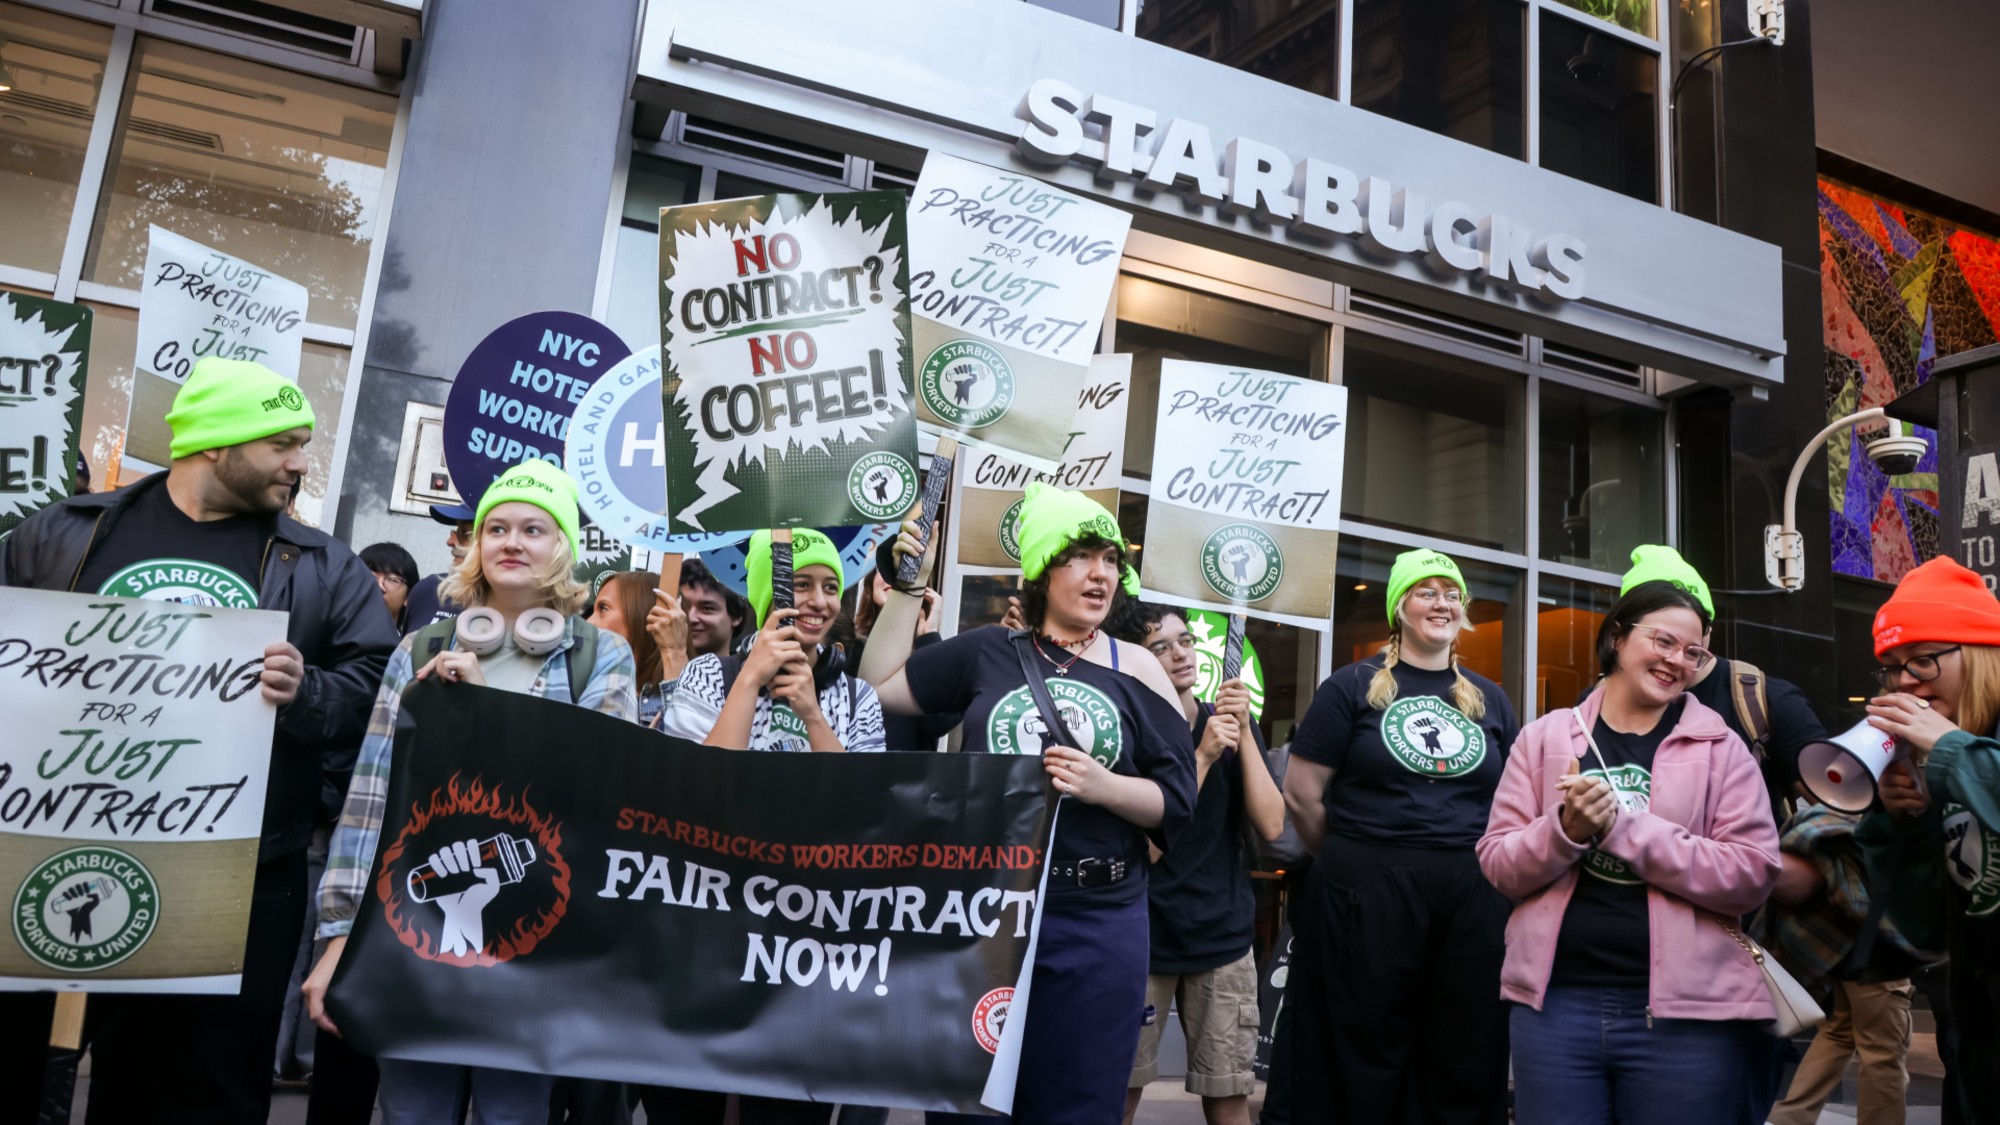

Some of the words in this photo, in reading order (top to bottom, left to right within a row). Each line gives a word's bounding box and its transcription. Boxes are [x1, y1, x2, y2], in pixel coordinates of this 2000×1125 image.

[981, 175, 1079, 219] JUST
[1019, 78, 1588, 300] STARBUCKS
[918, 187, 1117, 266] PRACTICING
[202, 253, 272, 293] JUST
[732, 232, 801, 277] NO
[983, 242, 1021, 264] FOR
[1022, 256, 1039, 269] A
[154, 262, 301, 333] PRACTICING
[681, 255, 884, 333] CONTRACT?
[951, 257, 1060, 306] JUST
[212, 314, 240, 333] FOR
[241, 327, 251, 338] A
[910, 270, 1088, 355] CONTRACT!
[538, 329, 601, 367] NYC
[747, 330, 817, 376] NO
[943, 345, 1008, 379] STARBUCKS
[510, 361, 591, 405] HOTE
[701, 348, 888, 441] COFFEE!
[925, 369, 958, 418] WORKERS
[971, 393, 1008, 421] UNITED
[1217, 371, 1301, 404] JUST
[478, 389, 572, 442] WORKE
[583, 391, 615, 435] AND
[1167, 390, 1341, 441] PRACTICING
[856, 455, 907, 474] STARBUCKS
[1230, 432, 1263, 449] FOR
[1265, 438, 1279, 451] A
[578, 443, 613, 510] HOTEL
[1208, 448, 1301, 486] JUST
[852, 485, 884, 515] WORKERS
[893, 482, 913, 511] UNITED
[1167, 466, 1330, 523] CONTRACT!
[1216, 527, 1275, 554] STARBUCKS
[1961, 536, 1996, 569] TO
[1205, 555, 1240, 595] WORKERS
[1251, 566, 1279, 596] UNITED
[65, 602, 213, 651] JUST
[0, 638, 266, 703] PRACTICING
[79, 702, 137, 726] FOR
[140, 706, 164, 728] A
[1397, 699, 1468, 729] STARBUCKS
[37, 729, 203, 783] JUST
[1386, 724, 1434, 771] WORKERS
[1448, 735, 1480, 770] UNITED
[616, 807, 786, 865] STARBUCKS
[791, 843, 919, 870] WORKERS
[921, 844, 1042, 871] DEMAND:
[41, 853, 144, 890] STARBUCKS
[597, 848, 731, 912] FAIR
[742, 875, 1037, 938] CONTRACT
[21, 902, 79, 962] WORKERS
[98, 908, 150, 959] UNITED
[740, 932, 893, 997] NOW!
